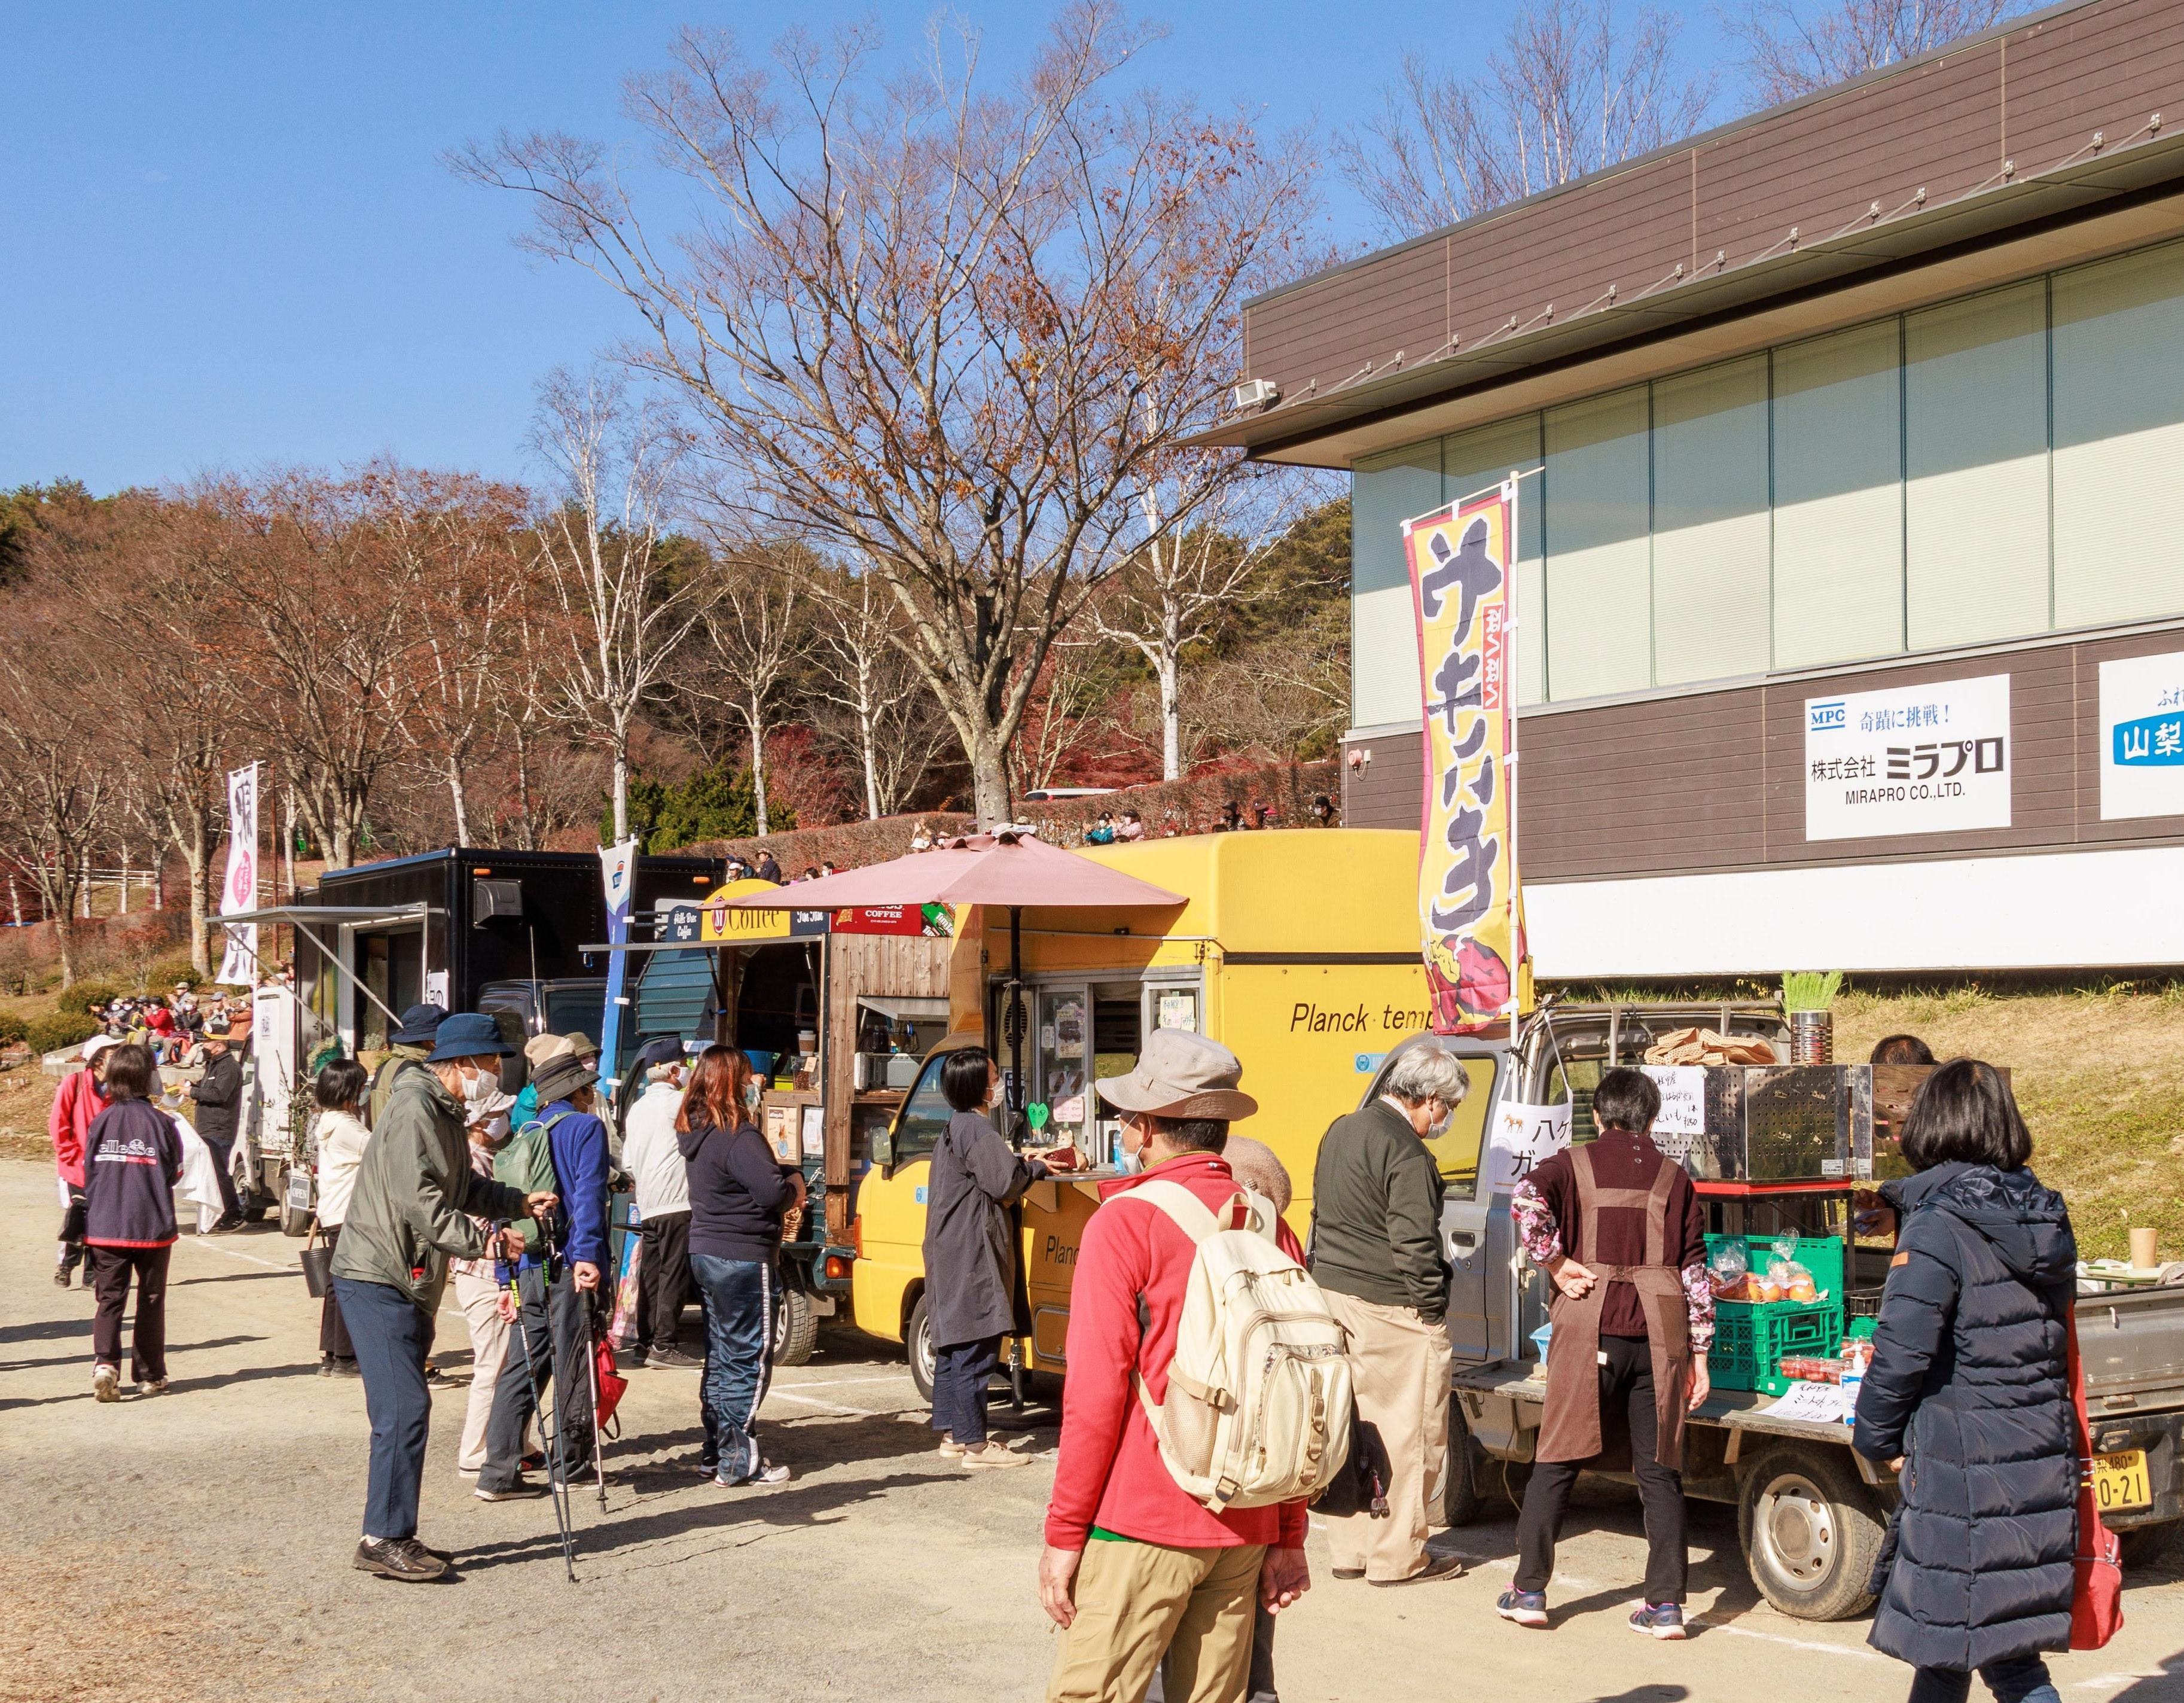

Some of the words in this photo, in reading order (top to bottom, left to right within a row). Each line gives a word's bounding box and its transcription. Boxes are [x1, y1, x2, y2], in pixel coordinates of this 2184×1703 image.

[1811, 708, 1846, 725] MPC
[1859, 703, 1949, 733] 奇蹟に挑戦！
[2124, 721, 2183, 760] 山梨
[1811, 755, 1876, 782] 株式会社
[1887, 736, 2003, 780] ミラプロ
[1846, 786, 1905, 805] MIRAPRO
[1910, 781, 1966, 801] CO.,LTD.
[865, 910, 902, 918] COFFEE
[1291, 1003, 1369, 1032] Planck
[99, 1140, 155, 1156] ellesse
[292, 1187, 307, 1199] OPEN
[2109, 1455, 2128, 1471] 480
[2095, 1473, 2143, 1507] 0-21
